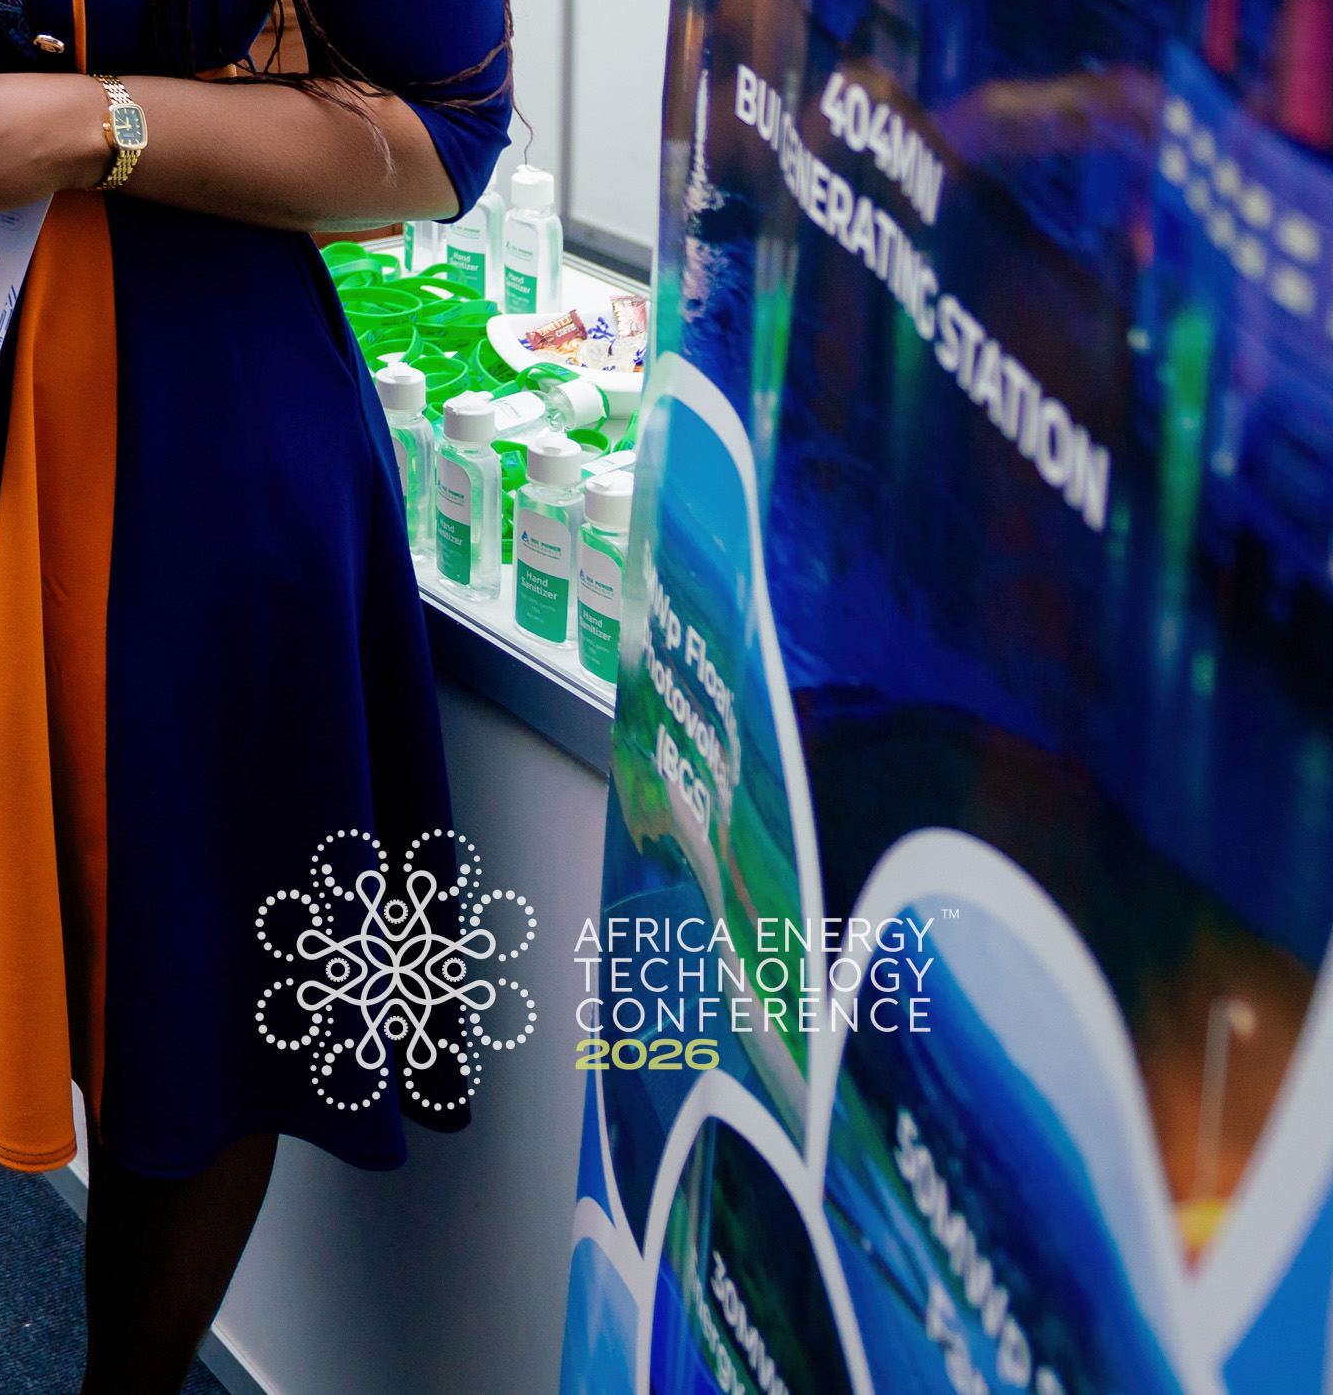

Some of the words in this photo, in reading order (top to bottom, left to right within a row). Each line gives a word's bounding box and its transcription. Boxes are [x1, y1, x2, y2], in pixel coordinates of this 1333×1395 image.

[735, 63, 782, 151] BUI
[778, 111, 940, 341] GENERATING
[934, 292, 1111, 532] STATION
[541, 542, 561, 553] POWER
[526, 570, 548, 587] Hand
[595, 581, 613, 593] POWER
[521, 576, 558, 600] Sanitizer
[583, 609, 603, 628] Hand
